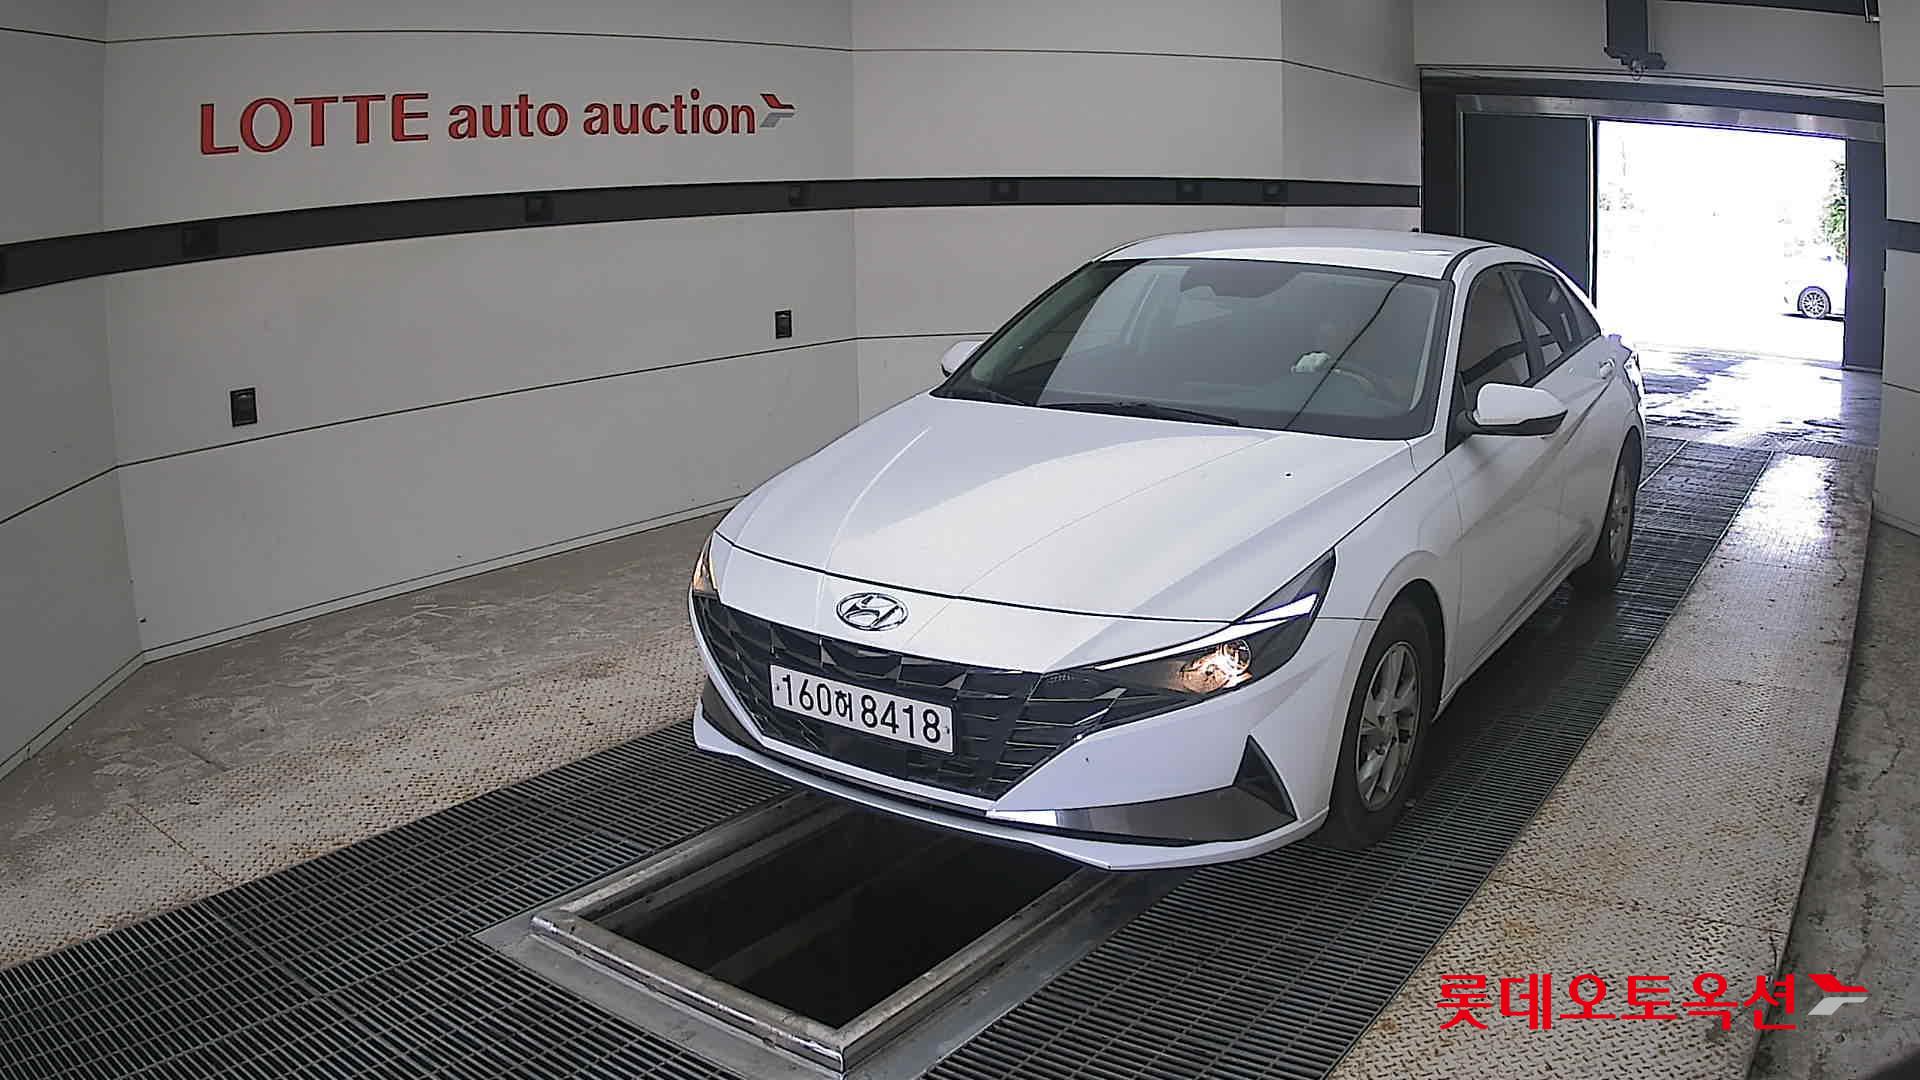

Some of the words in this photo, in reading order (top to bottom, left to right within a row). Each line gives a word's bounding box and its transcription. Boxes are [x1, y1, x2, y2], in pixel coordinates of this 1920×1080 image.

[200, 92, 430, 155] LOTTE
[448, 94, 568, 139] auto
[583, 88, 757, 136] auction
